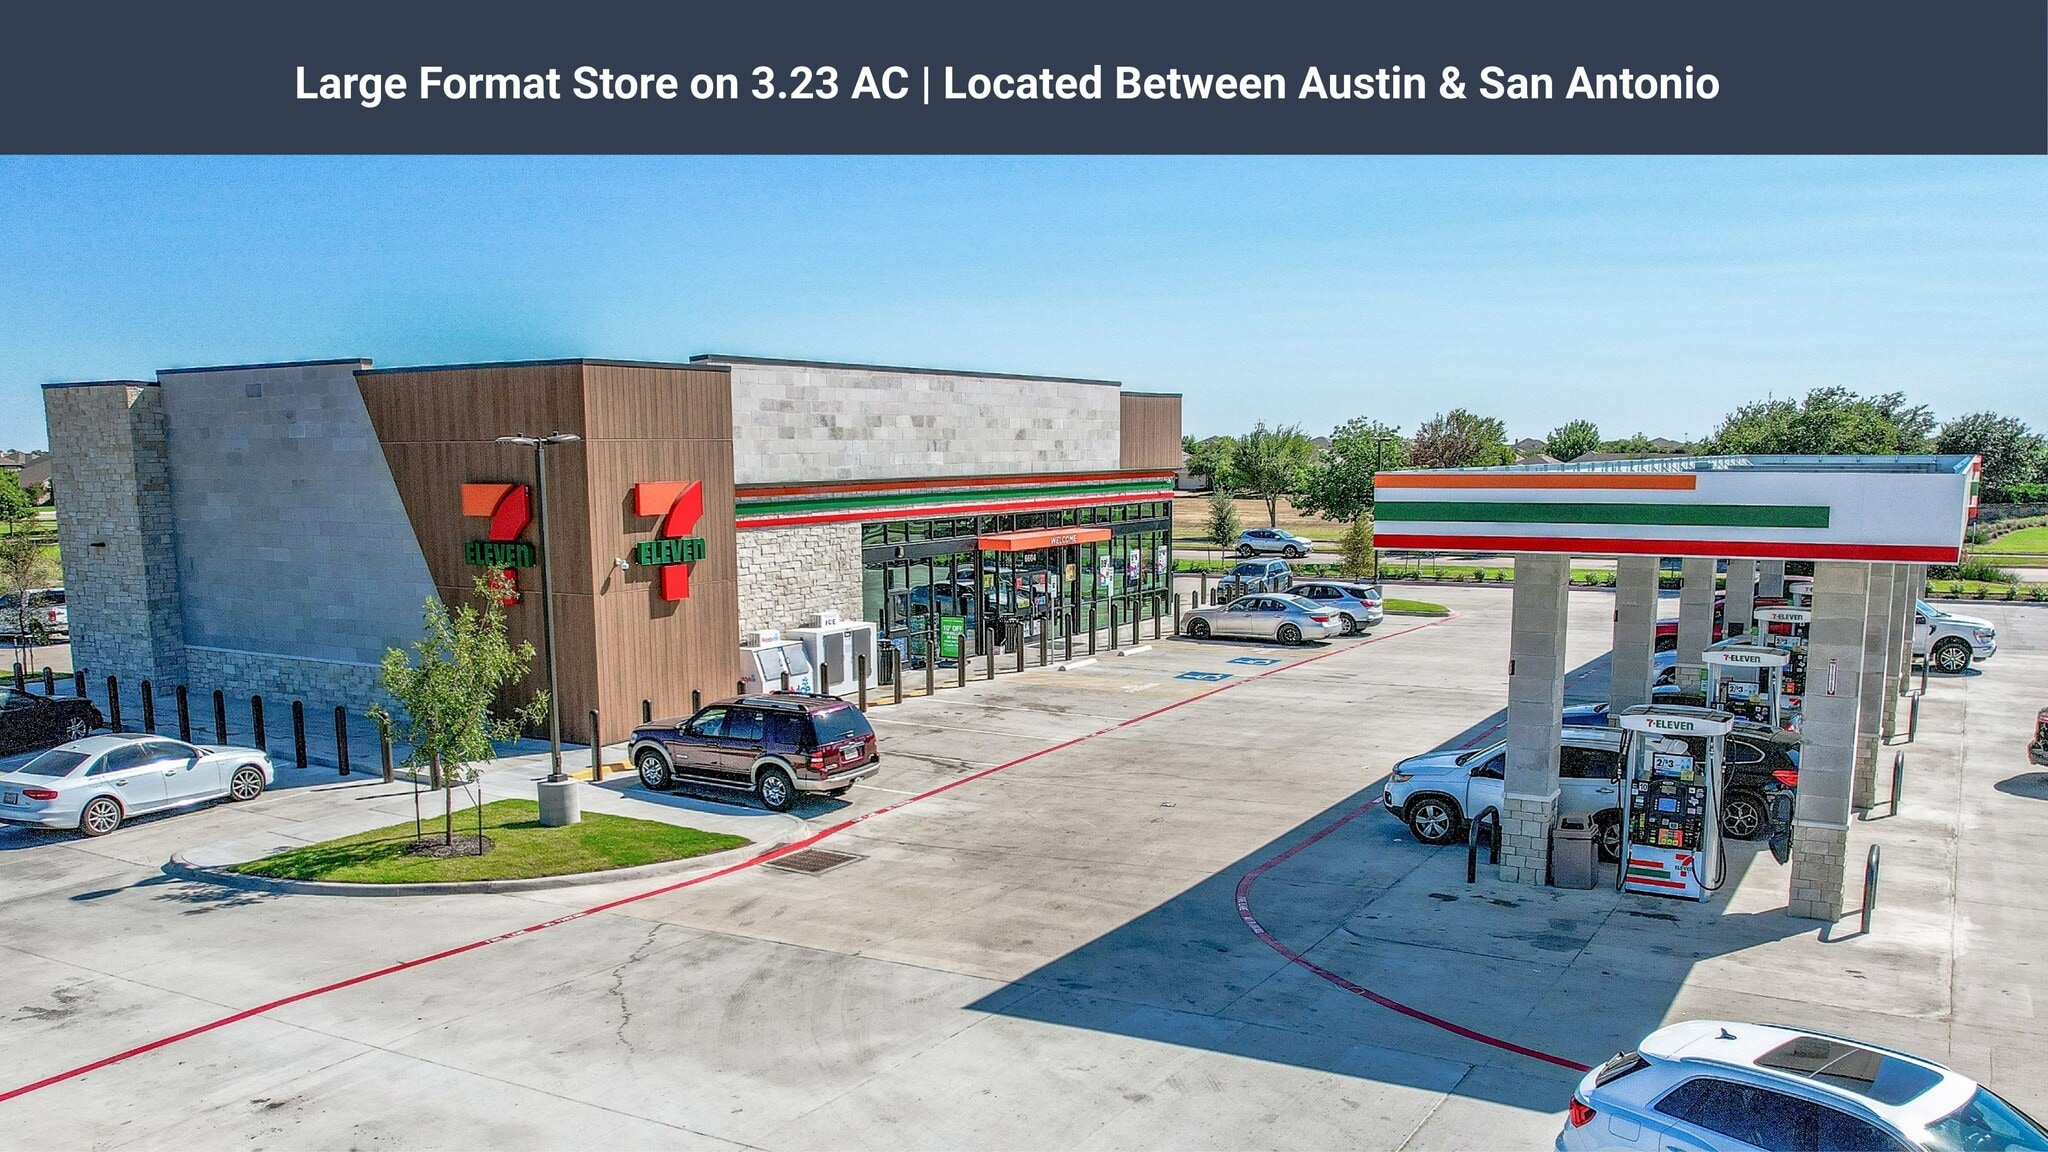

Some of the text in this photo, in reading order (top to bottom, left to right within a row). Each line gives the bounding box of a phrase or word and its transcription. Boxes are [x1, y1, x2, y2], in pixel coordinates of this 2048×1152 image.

[1050, 534, 1077, 545] WELCOME
[825, 618, 836, 626] ICE
[1639, 783, 1648, 791] 10
